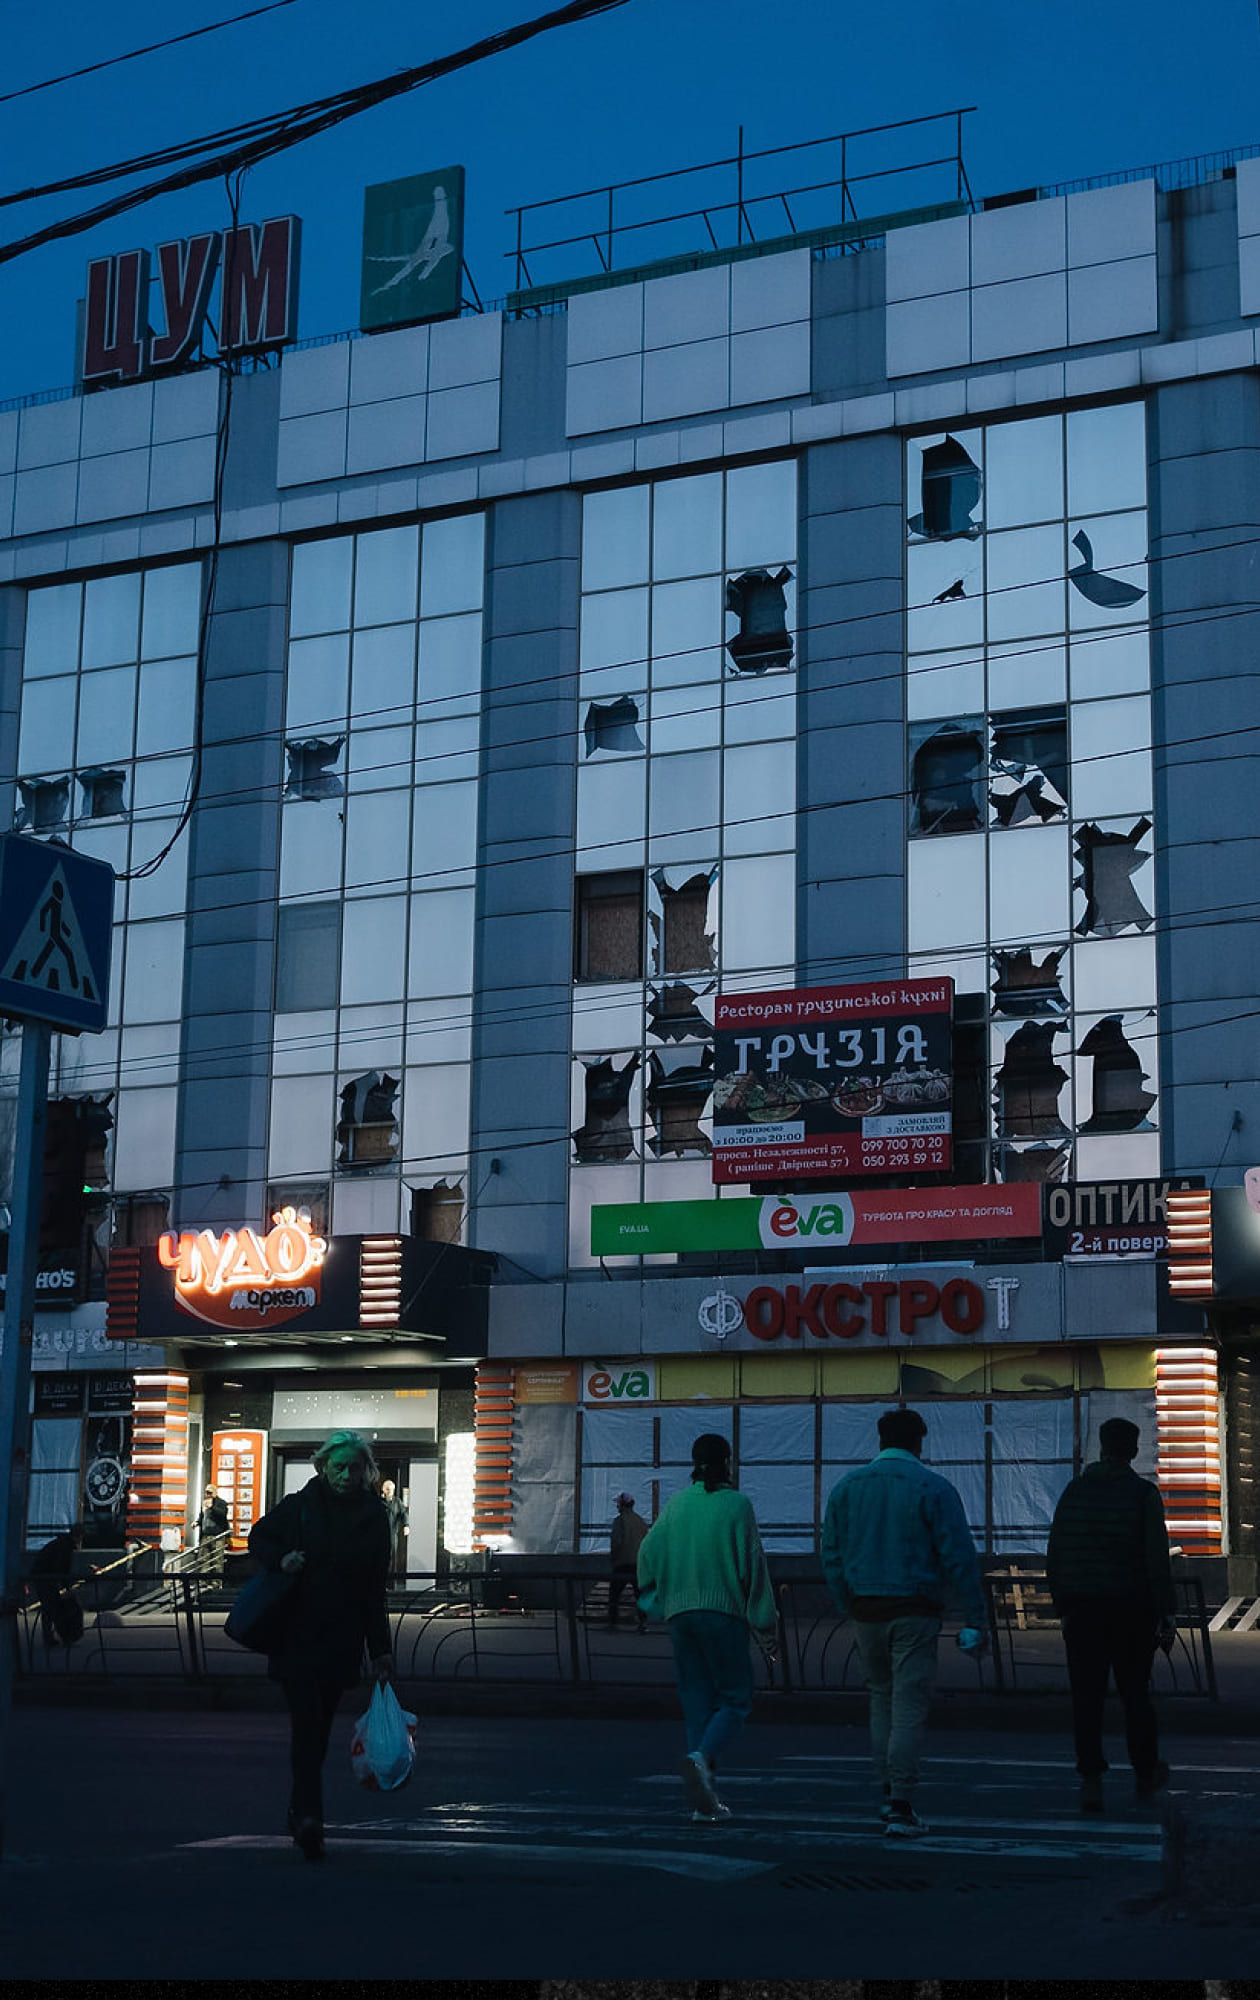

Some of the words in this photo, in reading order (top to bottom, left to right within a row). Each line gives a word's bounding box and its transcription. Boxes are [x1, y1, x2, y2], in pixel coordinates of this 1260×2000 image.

[83, 214, 302, 380] ЦУМ
[719, 1002, 793, 1019] Ресторан
[796, 993, 897, 1015] грузинської
[900, 986, 945, 1007] кухні
[733, 1024, 928, 1076] ГРУЗІЯ
[722, 1136, 754, 1145] 10:00
[768, 1133, 802, 1143] 20:00
[861, 1139, 884, 1152] 099
[886, 1138, 908, 1151] 700
[911, 1137, 925, 1149] 70
[927, 1136, 943, 1148] 20
[862, 1154, 886, 1167] 050
[888, 1153, 910, 1166] 293
[913, 1152, 927, 1164] 59
[931, 1151, 943, 1164] 12
[905, 1210, 925, 1220] ПРО
[926, 1208, 957, 1219] КРАСУ
[959, 1208, 971, 1218] ТА
[972, 1206, 1013, 1218] ДОГЛЯД
[618, 1225, 649, 1235] EVA.UA
[1070, 1231, 1102, 1254] 2-й
[158, 1222, 310, 1293] ЧУДО
[697, 1275, 1021, 1341] ФОКСТРОТ
